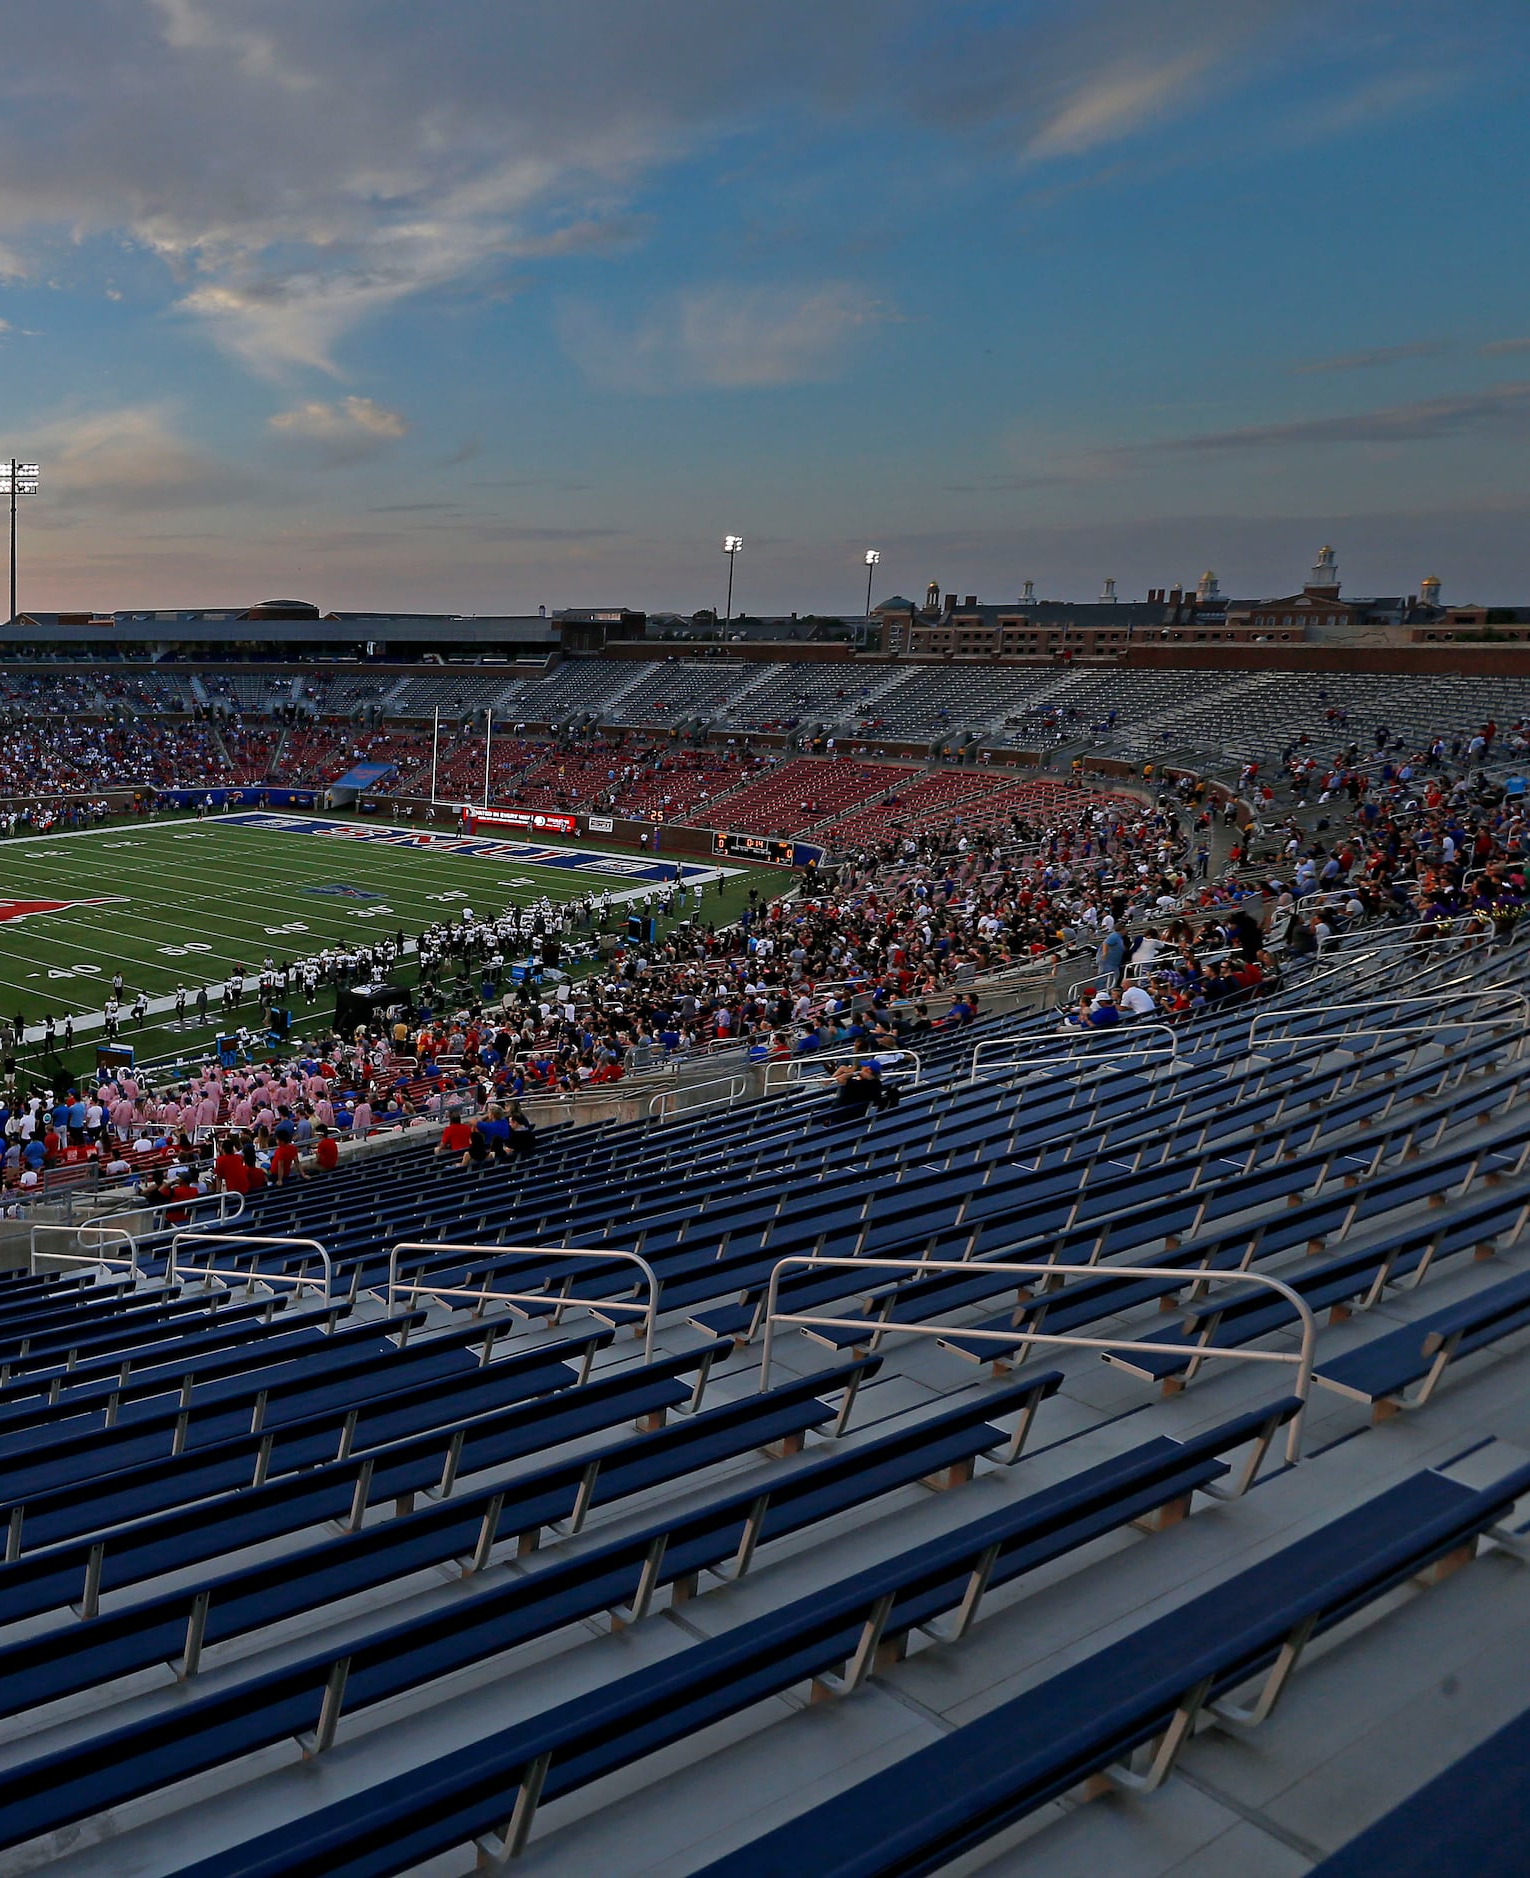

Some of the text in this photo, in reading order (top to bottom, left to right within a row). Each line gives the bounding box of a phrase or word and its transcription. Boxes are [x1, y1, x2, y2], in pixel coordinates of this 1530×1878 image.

[650, 810, 664, 821] 25
[312, 826, 577, 862] SMU
[718, 839, 725, 848] 0
[746, 838, 764, 849] 0:14
[786, 849, 793, 859] 0
[497, 877, 536, 888] 10
[426, 890, 469, 902] 20
[346, 905, 395, 918] 30
[264, 920, 311, 935] 40
[156, 942, 213, 957] 50
[47, 964, 103, 980] 40
